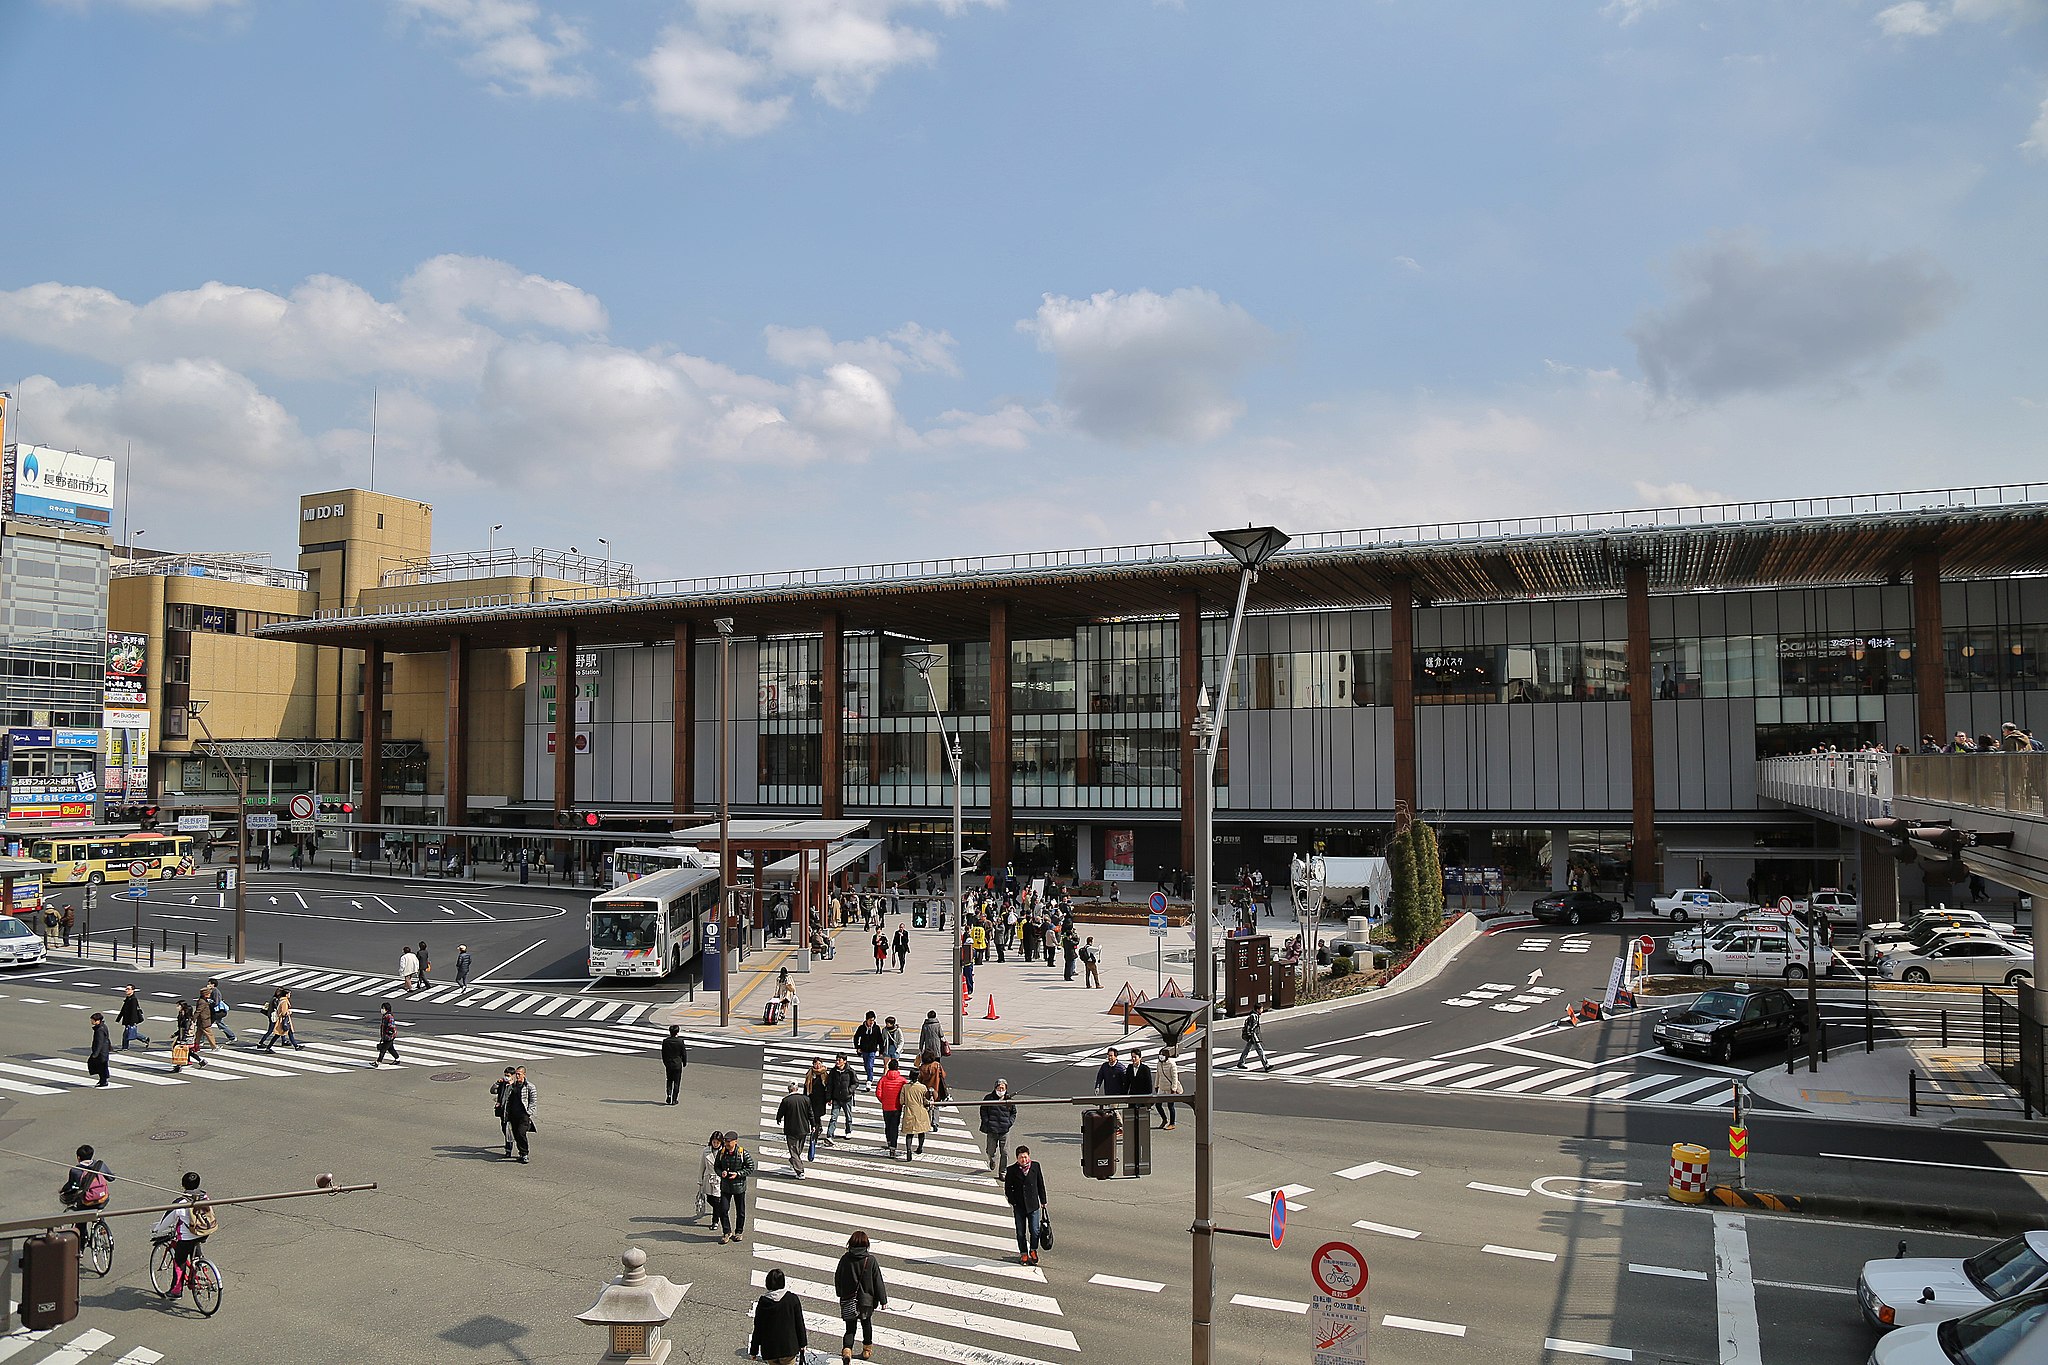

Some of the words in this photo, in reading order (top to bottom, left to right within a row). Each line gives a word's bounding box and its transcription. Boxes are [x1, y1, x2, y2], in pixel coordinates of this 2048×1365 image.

[44, 474, 108, 494] 長野都市ガス
[121, 712, 141, 720] Budget
[18, 778, 75, 786] 長野フォレスト歯科
[35, 794, 84, 802] 英会話イーオン
[62, 805, 85, 815] Daily
[1312, 1295, 1332, 1303] 自転車
[1333, 1302, 1367, 1313] の放置禁止
